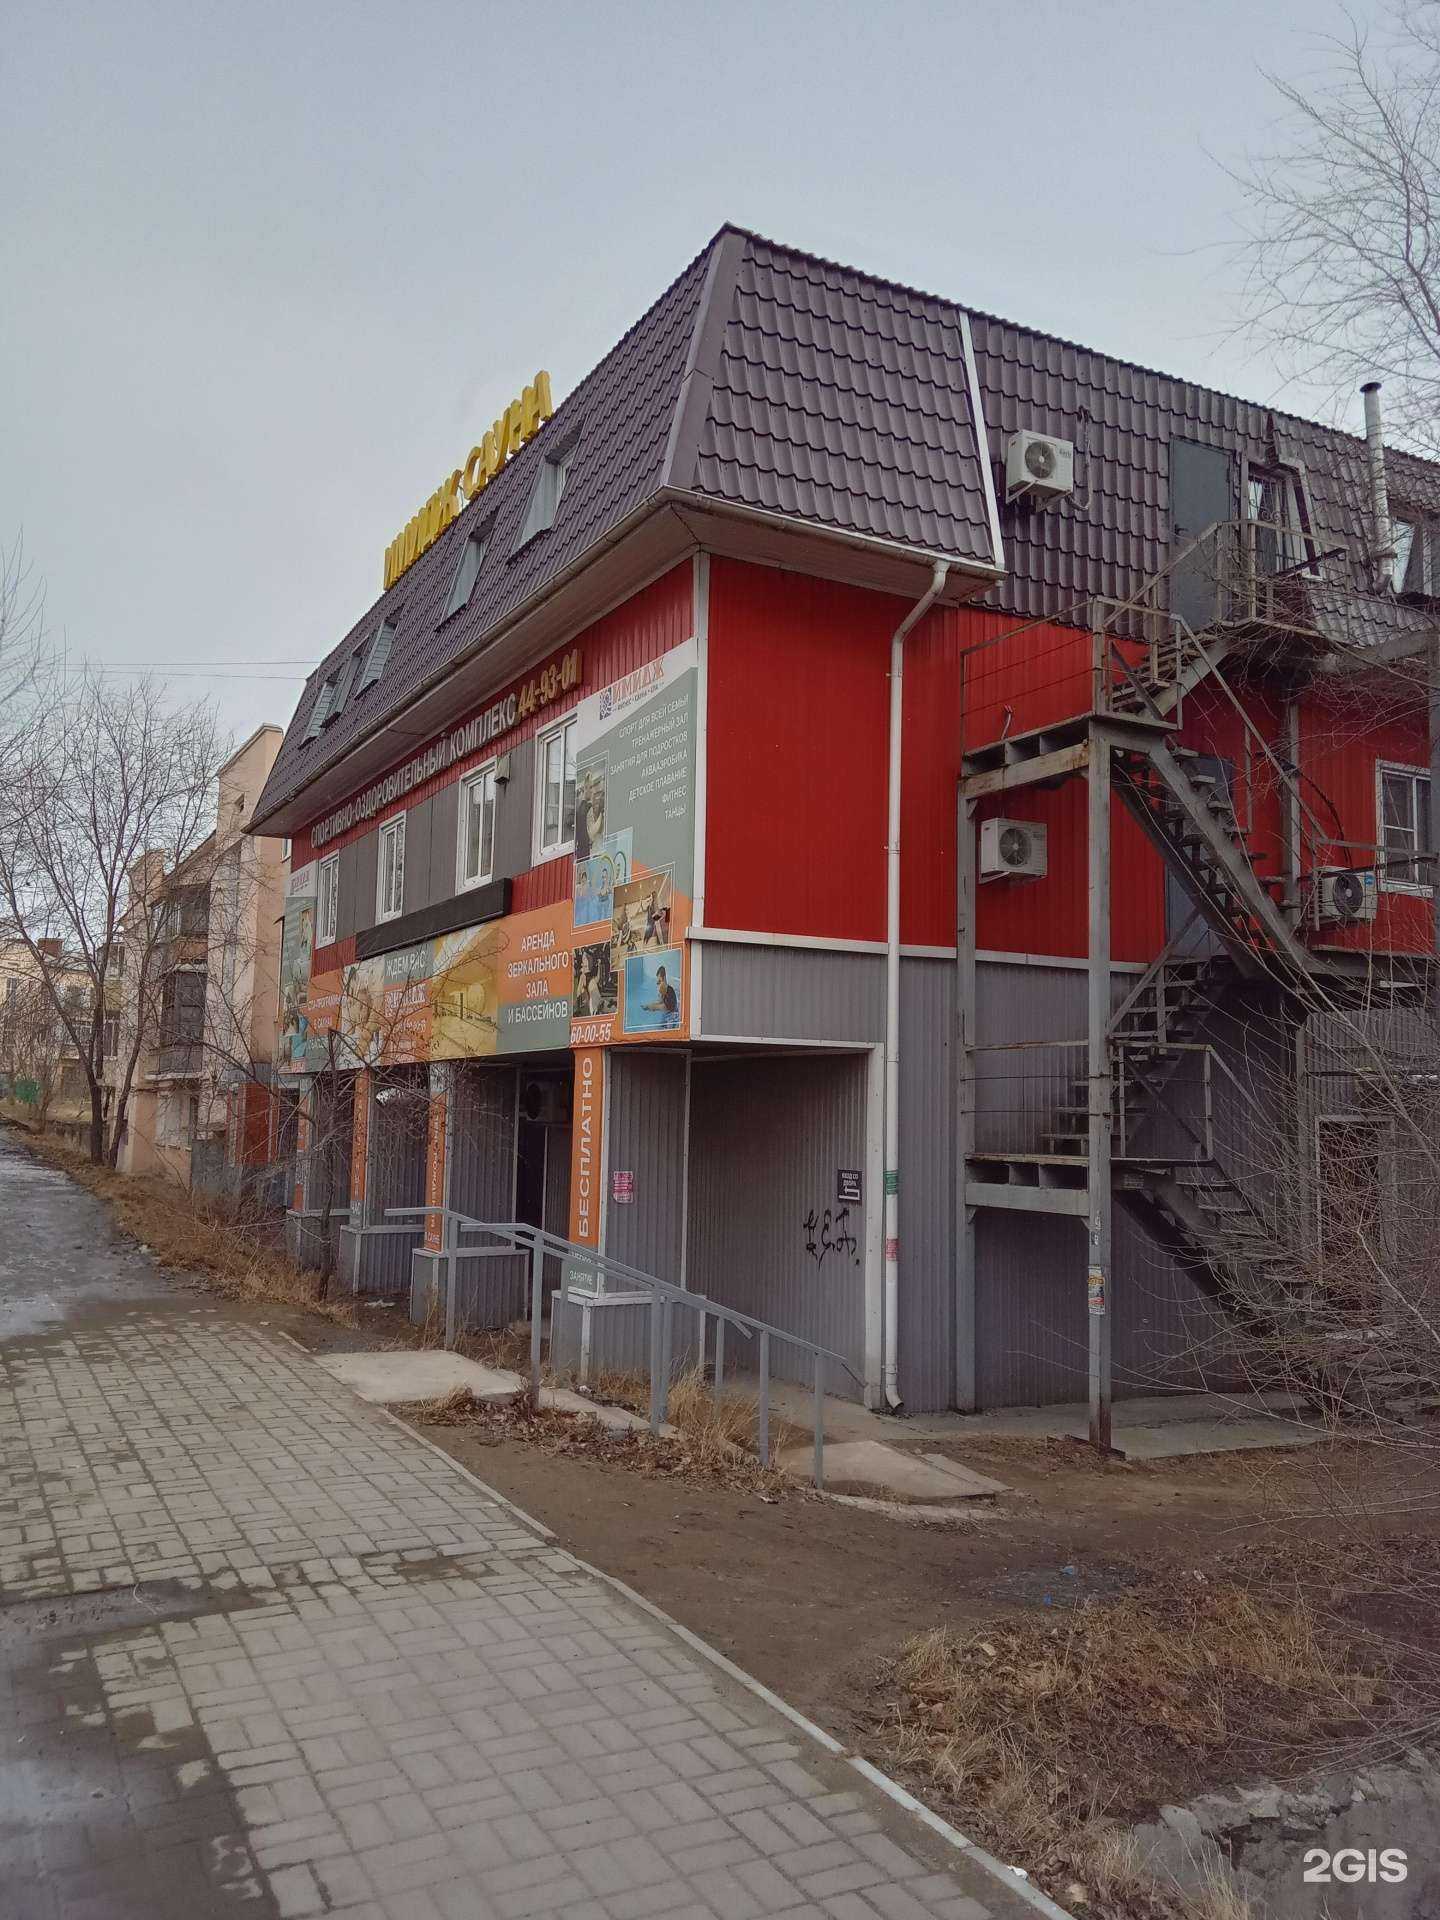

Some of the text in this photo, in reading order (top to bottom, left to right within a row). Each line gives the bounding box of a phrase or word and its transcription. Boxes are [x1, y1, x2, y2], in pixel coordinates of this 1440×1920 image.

[463, 370, 552, 500] САУНА
[612, 656, 664, 704] ИМИДЖ
[619, 721, 638, 738] СПОРТ
[639, 715, 650, 730] ДЛЯ
[651, 704, 667, 722] ВСЕЙ
[632, 712, 688, 749] ТРЕНАЖЕРНЫЙ ЗАЛ
[311, 648, 580, 849] СПОРТИВНО-ОЗДОРОВИТЕЛЬНЫЙ КОМПЛЕКС 44-93-01
[610, 755, 634, 775] ЗАНЯТИЯ
[649, 731, 687, 758] ПОДРОСТКОВ
[628, 766, 688, 805] ДЕТСКОЕ ПЛАВАНИЕ
[662, 785, 687, 803] ФИТНЕС
[664, 804, 686, 820] ТАНЦЫ
[520, 930, 555, 953] АРЕНДА
[386, 955, 409, 980] ЖДЕМ
[508, 952, 569, 978] ЗЕРКАЛЬНОГО
[526, 979, 549, 998] ЗАЛА
[508, 1001, 568, 1024] И БАССЕЙНОВ
[571, 1023, 611, 1044] 60-00-55
[578, 1057, 593, 1238] БЕСПЛАТНО
[569, 1270, 593, 1286] ЗАНЯТИЕ
